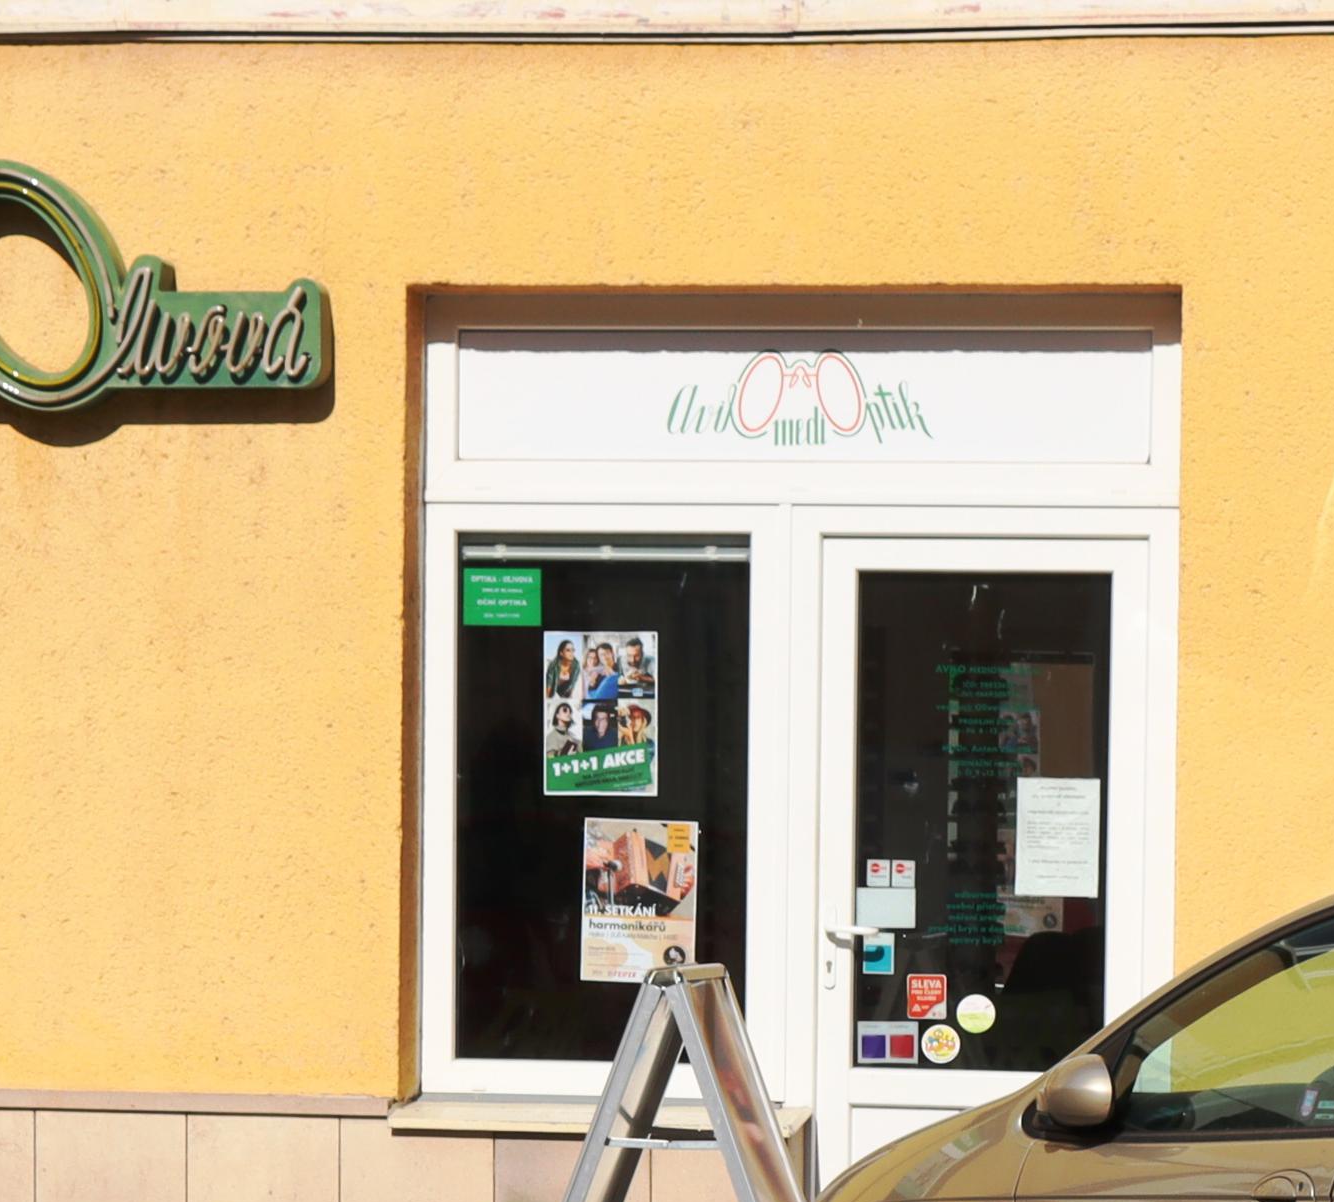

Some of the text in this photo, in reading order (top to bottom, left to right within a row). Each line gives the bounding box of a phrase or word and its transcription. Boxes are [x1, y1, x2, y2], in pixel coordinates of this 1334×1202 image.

[551, 756, 598, 777] 1+1+1
[603, 748, 646, 769] AKCE
[605, 897, 657, 918] SETKÁNÍ
[588, 919, 667, 932] harmonikářů
[911, 979, 942, 989] SLEVA
